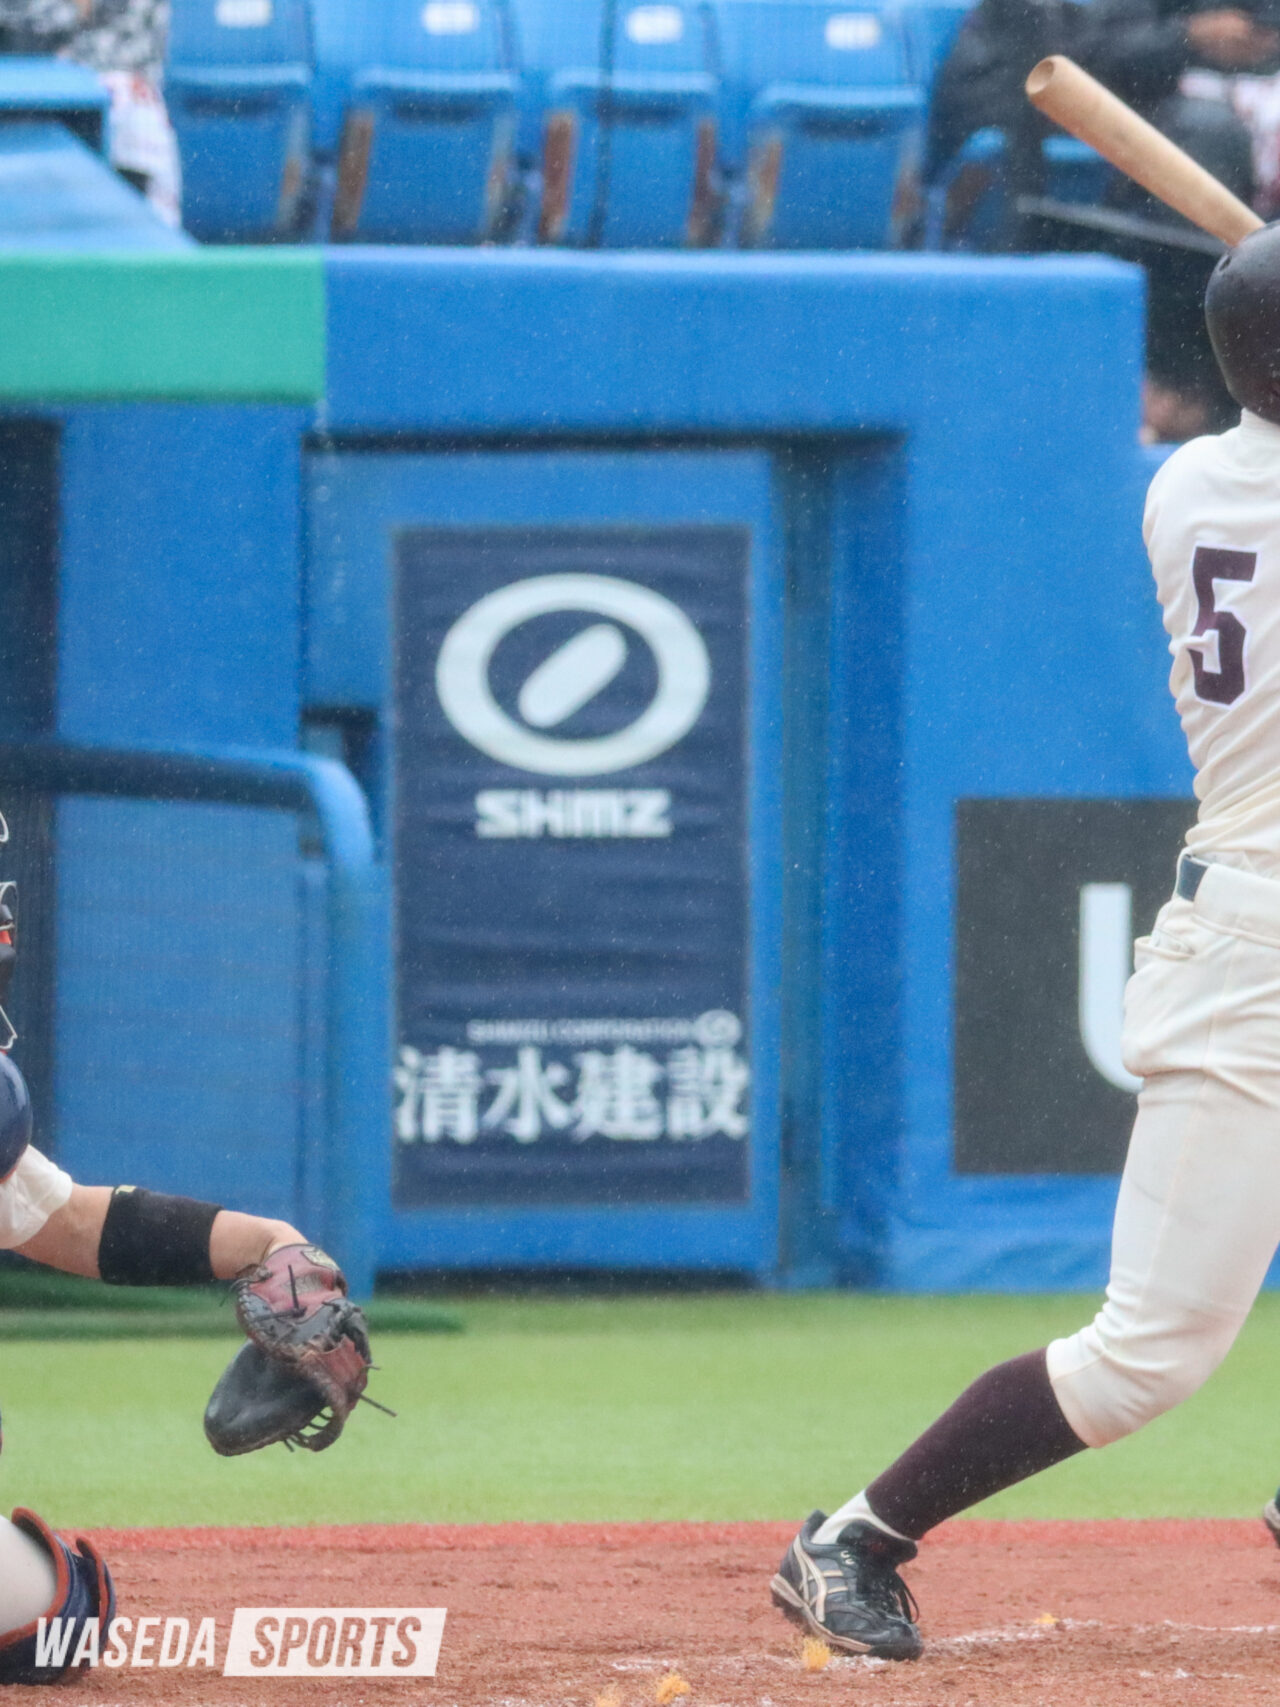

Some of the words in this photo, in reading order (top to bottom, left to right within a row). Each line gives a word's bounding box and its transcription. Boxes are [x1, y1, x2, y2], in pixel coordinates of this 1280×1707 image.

[1187, 542, 1259, 711] 5
[394, 1045, 750, 1144] 清水建設
